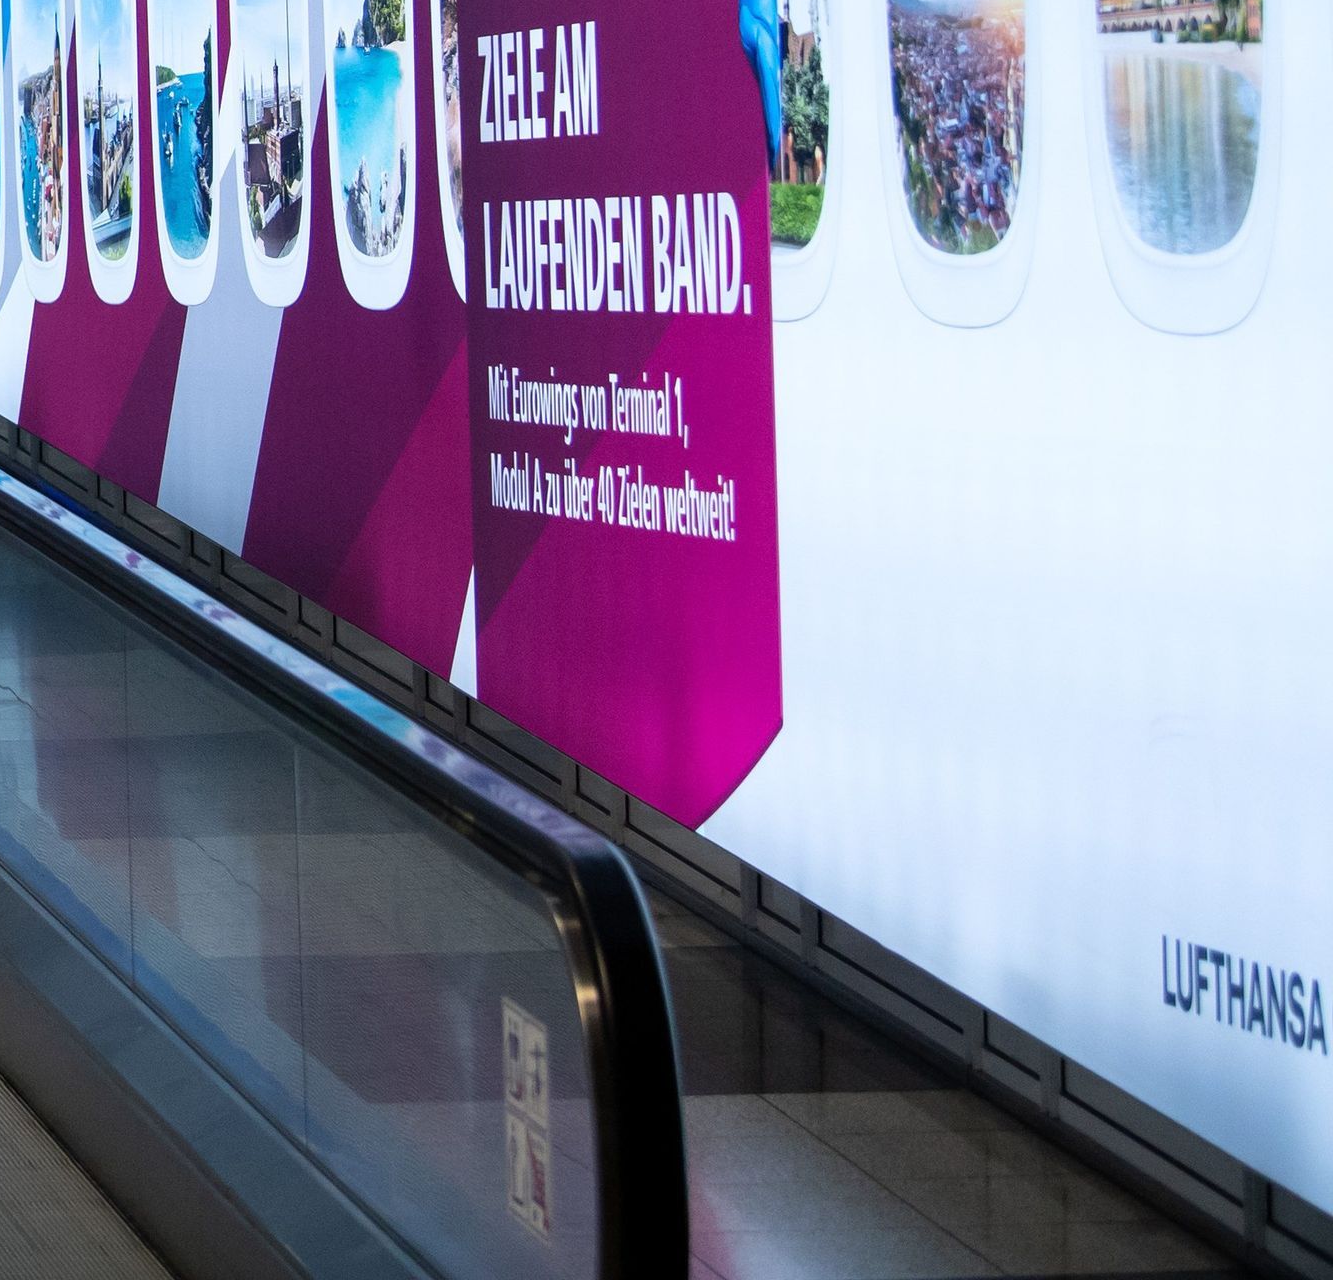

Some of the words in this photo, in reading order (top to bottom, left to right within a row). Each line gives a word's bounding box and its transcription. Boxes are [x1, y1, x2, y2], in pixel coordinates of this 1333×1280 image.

[477, 28, 546, 143] ZIELE
[553, 20, 599, 138] AM
[483, 195, 644, 313] LAUFENDEN
[651, 192, 752, 315] BAND.
[488, 363, 510, 422] Mit
[511, 366, 579, 446] Eurowings
[580, 385, 607, 431] von
[608, 371, 671, 436] Terminal
[674, 377, 689, 449] 1,
[490, 451, 530, 512] Modul
[533, 457, 544, 514] A
[545, 472, 561, 517] zu
[563, 457, 594, 521] über
[597, 465, 615, 525] 40
[617, 464, 661, 531] Zielen
[663, 469, 735, 541] weltweit!
[1162, 934, 1328, 1056] LUFTHANSA
